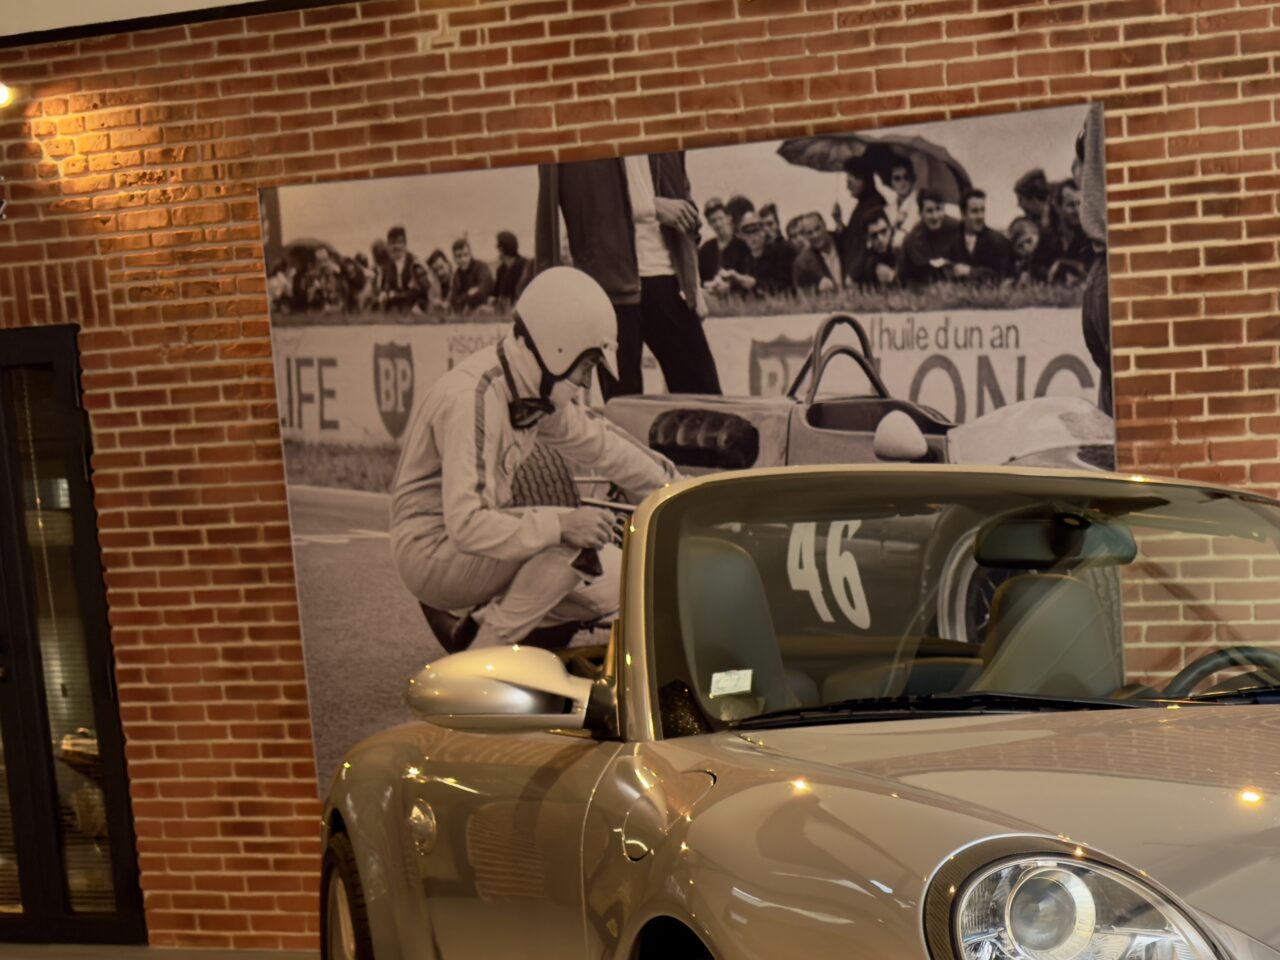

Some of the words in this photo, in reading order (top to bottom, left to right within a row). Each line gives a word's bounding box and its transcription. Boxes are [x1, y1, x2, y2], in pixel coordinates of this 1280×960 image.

[990, 323, 1020, 350] an
[281, 357, 340, 430] IFE
[377, 357, 412, 413] BP
[787, 519, 871, 630] 46
